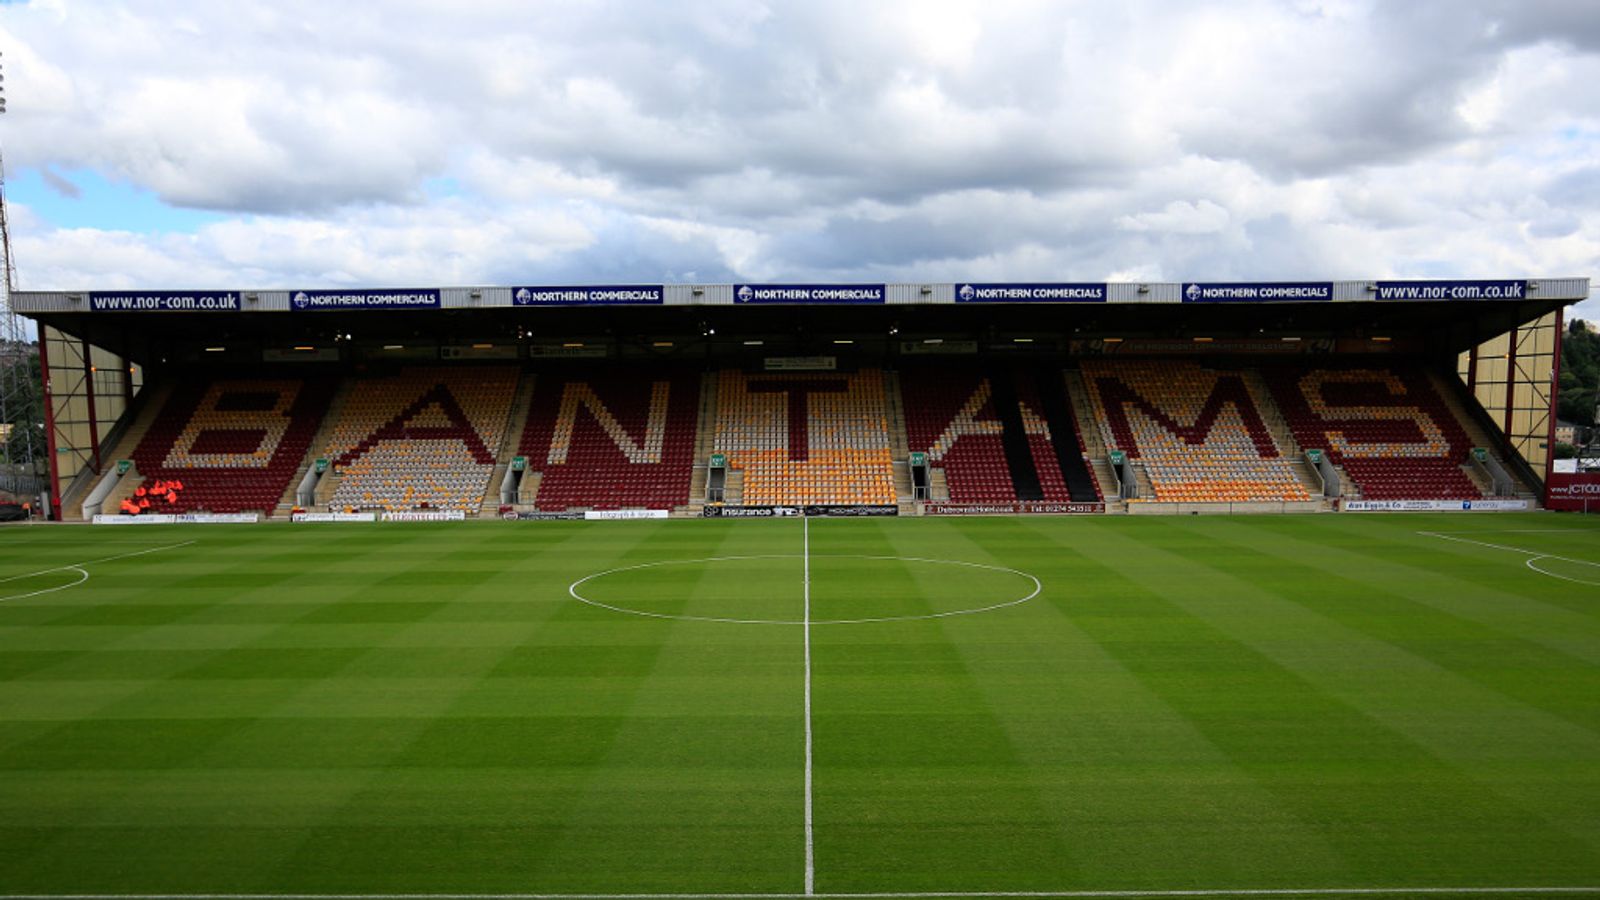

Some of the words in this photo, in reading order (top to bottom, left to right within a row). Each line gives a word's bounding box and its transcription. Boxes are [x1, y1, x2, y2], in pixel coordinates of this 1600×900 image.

[533, 291, 588, 301] NORTHERN
[590, 290, 659, 300] COMMERCIALS
[755, 289, 810, 299] NORTHERN
[812, 289, 881, 299] COMMERCIALS
[976, 288, 1031, 298] NORTHERN
[1033, 288, 1102, 298] COMMERCIALS
[1203, 288, 1257, 298] NORTHERN
[1259, 287, 1328, 297] COMMERCIALS
[1380, 282, 1521, 298] www.nor-com.co.uk
[94, 294, 236, 309] www.nor-com.co.uk
[311, 295, 365, 305] NORTHERN
[367, 294, 436, 304] COMMERCIALS
[721, 507, 771, 516] Insurance
